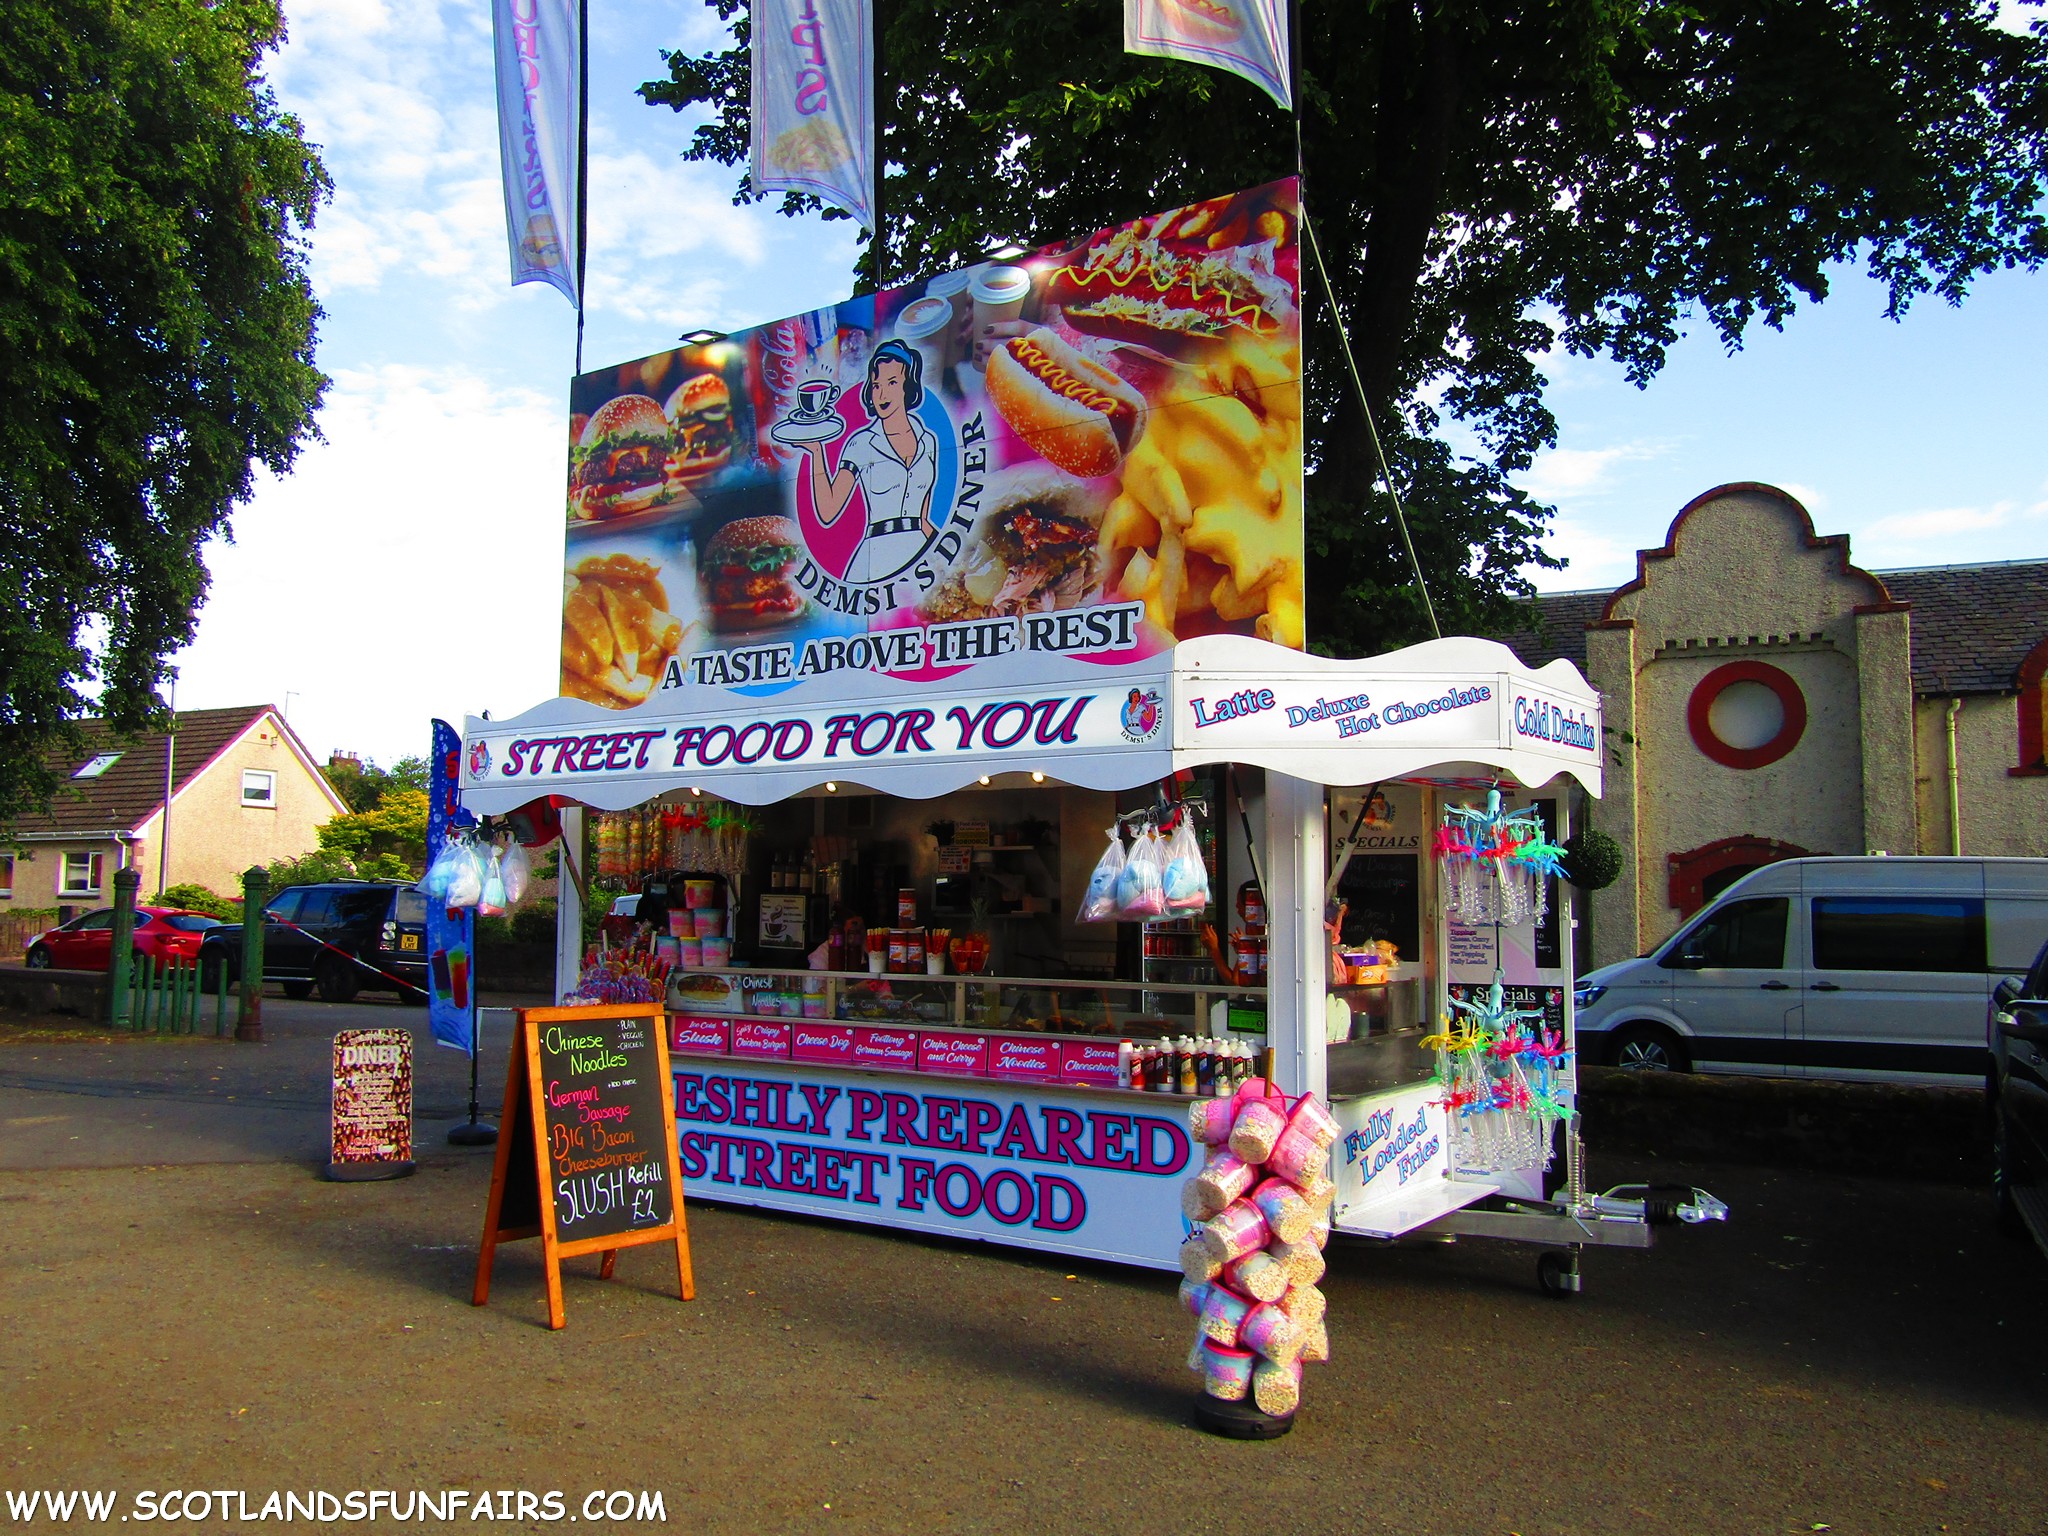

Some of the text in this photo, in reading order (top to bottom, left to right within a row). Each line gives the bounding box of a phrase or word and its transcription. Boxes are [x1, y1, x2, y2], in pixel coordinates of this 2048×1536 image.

[934, 411, 987, 565] DINER
[661, 607, 1140, 690] A TASTE ABOVE THE REST
[1189, 685, 1276, 728] Latte
[1285, 692, 1370, 728] Deluxe
[1336, 683, 1491, 739] Hot Chocolate
[1151, 707, 1163, 736] DINER
[1514, 696, 1596, 752] Cold Drinks
[501, 728, 666, 777] STREET
[673, 718, 814, 768] FOOD
[823, 707, 935, 758] FOR
[946, 694, 1099, 750] YOU
[1335, 836, 1419, 848] SECIALS
[742, 976, 773, 989] Chinese
[1475, 987, 1536, 1002] Spcials
[752, 993, 782, 1008] Noodles
[679, 1030, 722, 1046] Slush
[700, 1021, 717, 1030] Cold
[753, 1025, 781, 1039] Crispy
[546, 1027, 604, 1055] Chinese
[735, 1037, 788, 1051] Chicken Burger
[796, 1032, 850, 1051] Cheese Dog
[855, 1044, 914, 1059] German Sausage
[869, 1033, 905, 1047] Footlong
[922, 1038, 982, 1053] Chips, Cheese
[1000, 1042, 1046, 1056] Chinese
[1083, 1047, 1117, 1059] Bacon
[344, 1046, 402, 1065] DINER
[570, 1050, 628, 1076] Noodles
[926, 1053, 976, 1067] and Curry
[996, 1056, 1047, 1070] Noodles
[1065, 1060, 1120, 1075] Cheeseburg
[549, 1081, 600, 1108] German
[578, 1102, 631, 1123] Sausage
[674, 1073, 1192, 1178] ESHLY PREPARED
[553, 1121, 635, 1160] BIG Bacon
[1344, 1107, 1394, 1165] Fully
[1360, 1106, 1428, 1187] Loaded
[559, 1150, 648, 1177] Cheeseburger
[1396, 1134, 1440, 1186] Fries
[558, 1162, 663, 1225] SLUSH Refill
[679, 1130, 1088, 1233] STREET FOOD
[632, 1189, 659, 1220] £2
